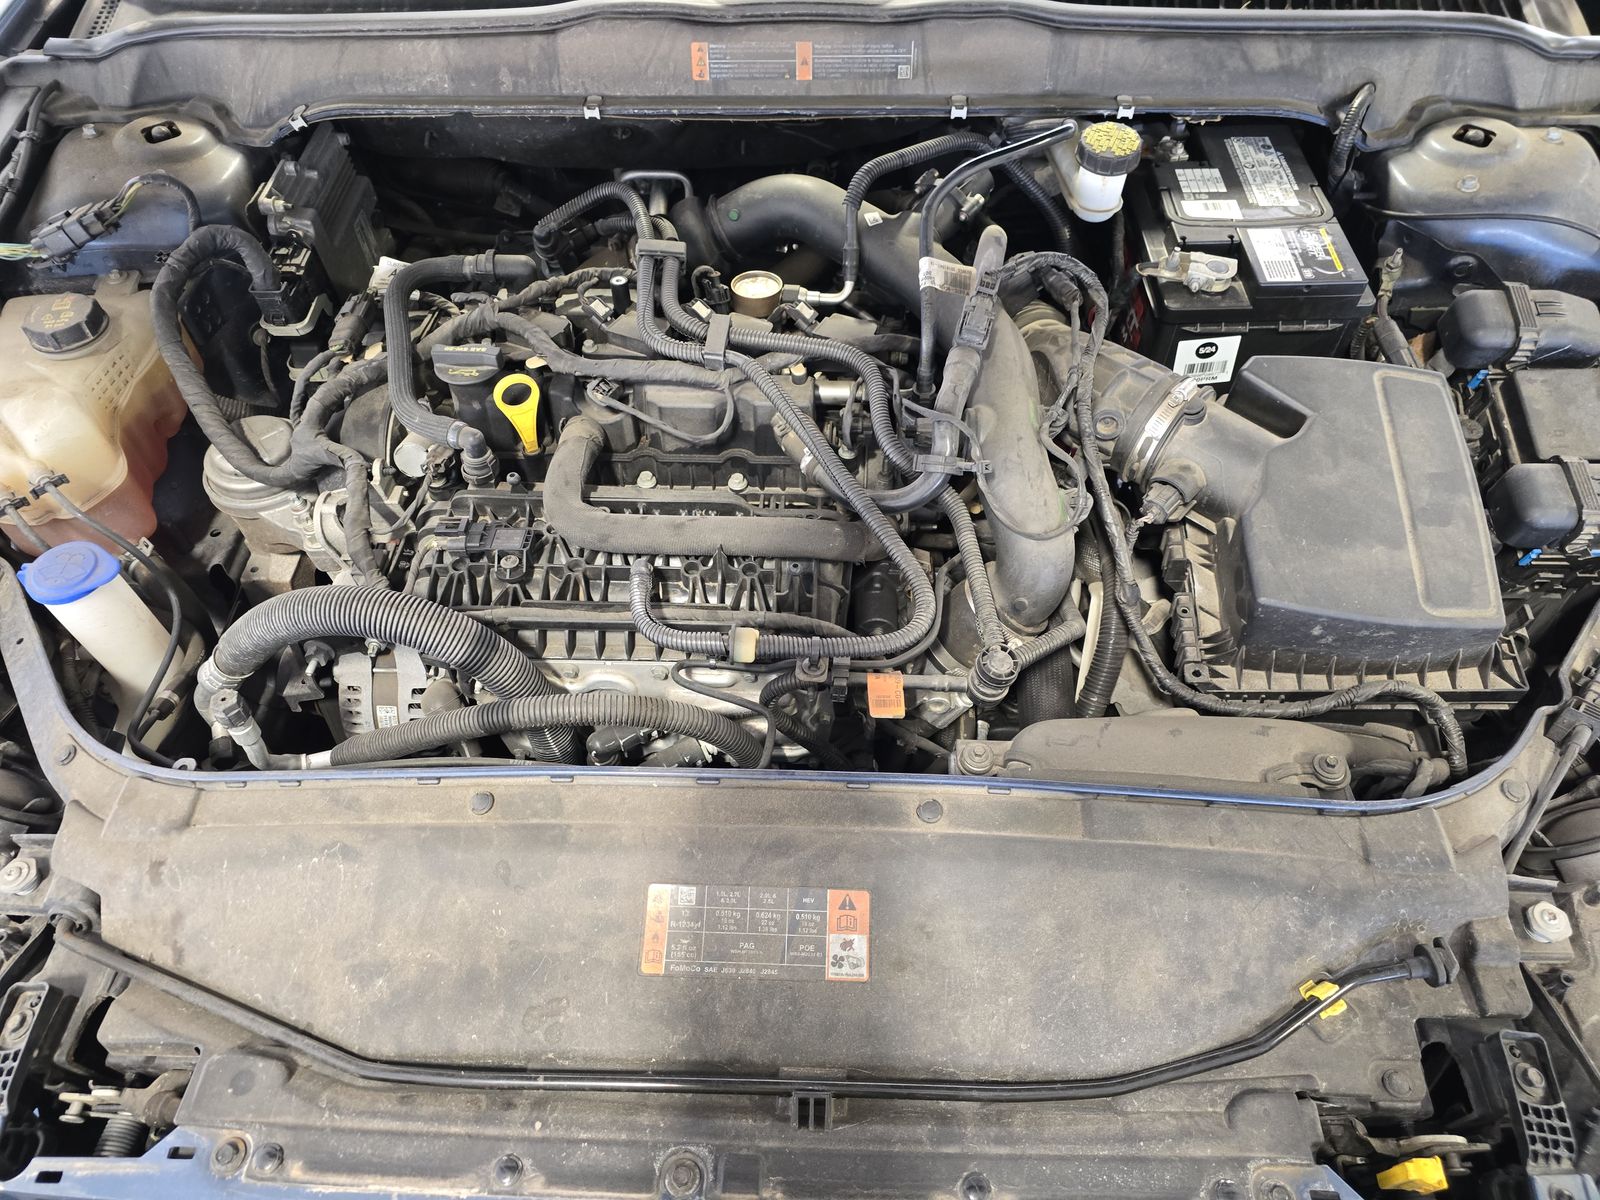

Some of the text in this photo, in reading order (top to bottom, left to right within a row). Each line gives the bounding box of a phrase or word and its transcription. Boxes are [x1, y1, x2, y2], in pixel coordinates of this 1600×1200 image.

[1198, 345, 1217, 354] 5/24
[732, 910, 740, 919] kg
[772, 912, 781, 922] kg
[812, 914, 820, 922] kg
[670, 920, 701, 929] R-1234yf
[670, 964, 701, 972] FoMoCo
